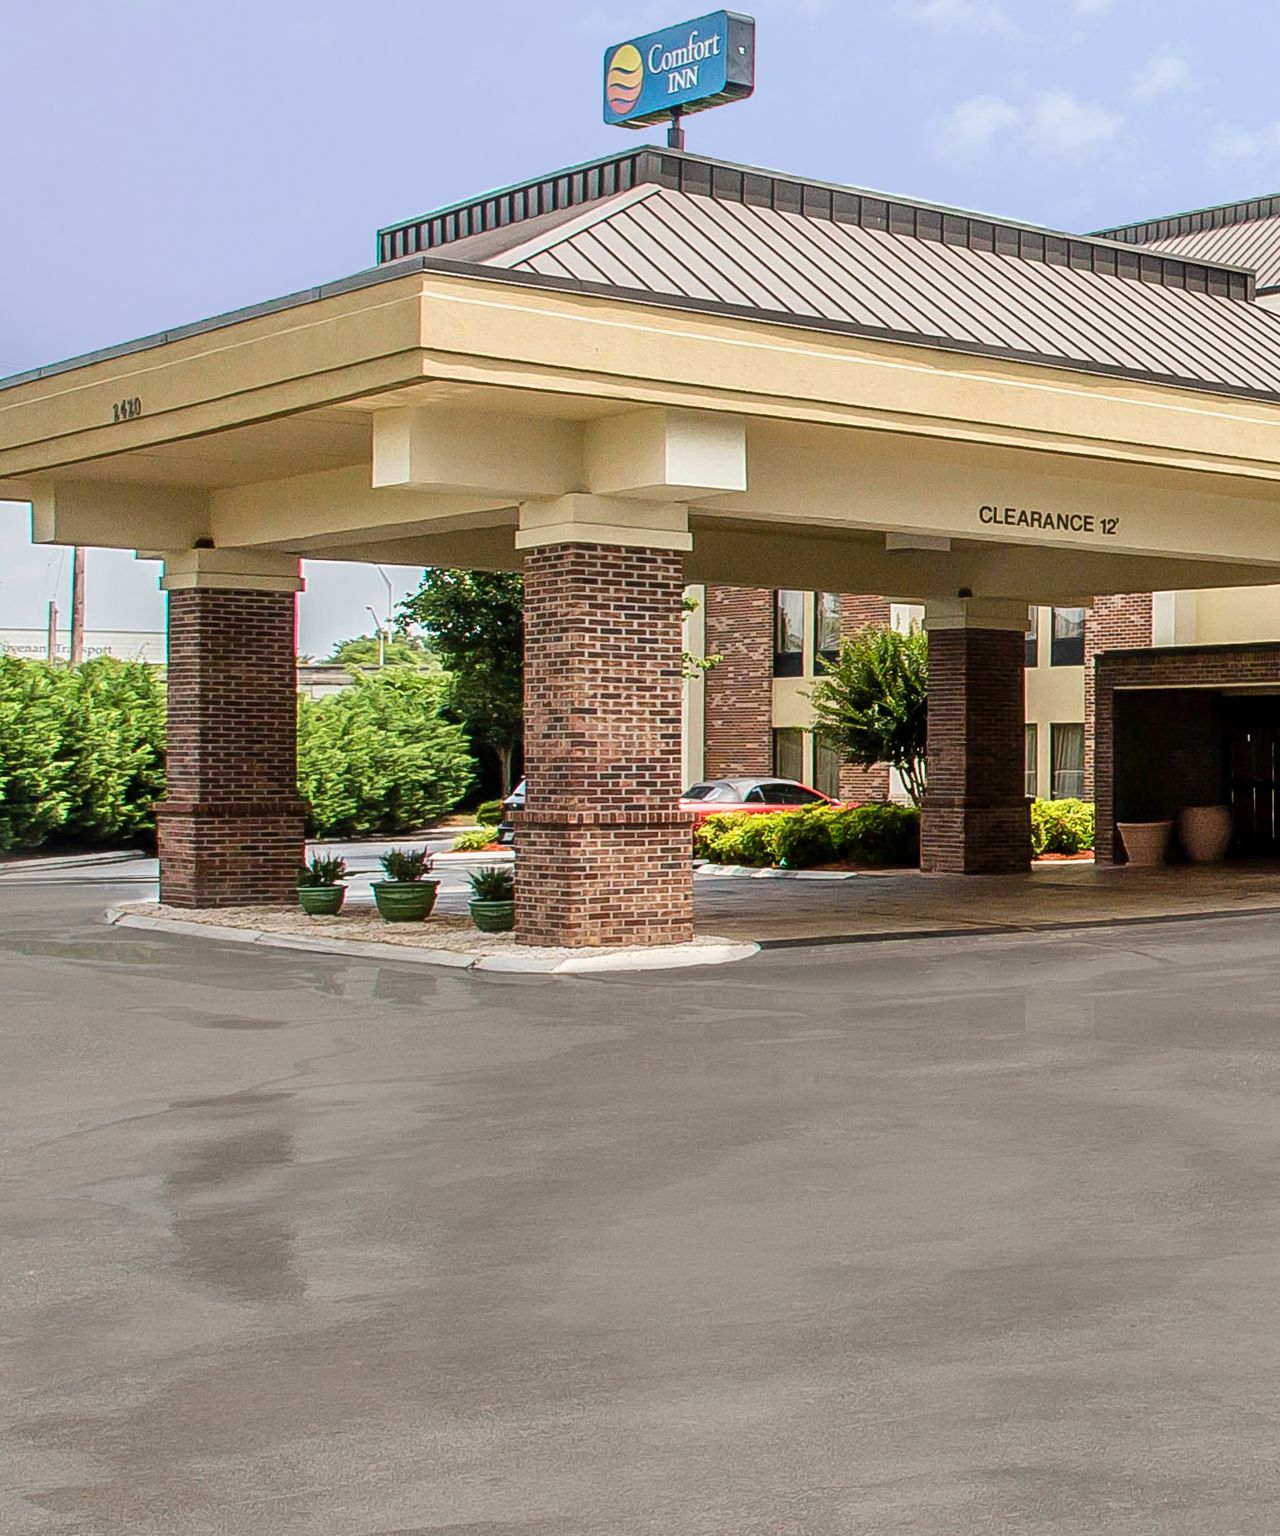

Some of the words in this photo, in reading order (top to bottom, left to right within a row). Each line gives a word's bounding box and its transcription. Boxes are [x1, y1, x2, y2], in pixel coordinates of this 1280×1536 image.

[648, 30, 721, 74] Comfort
[667, 66, 699, 94] INN
[979, 505, 1094, 533] CLEARANCE
